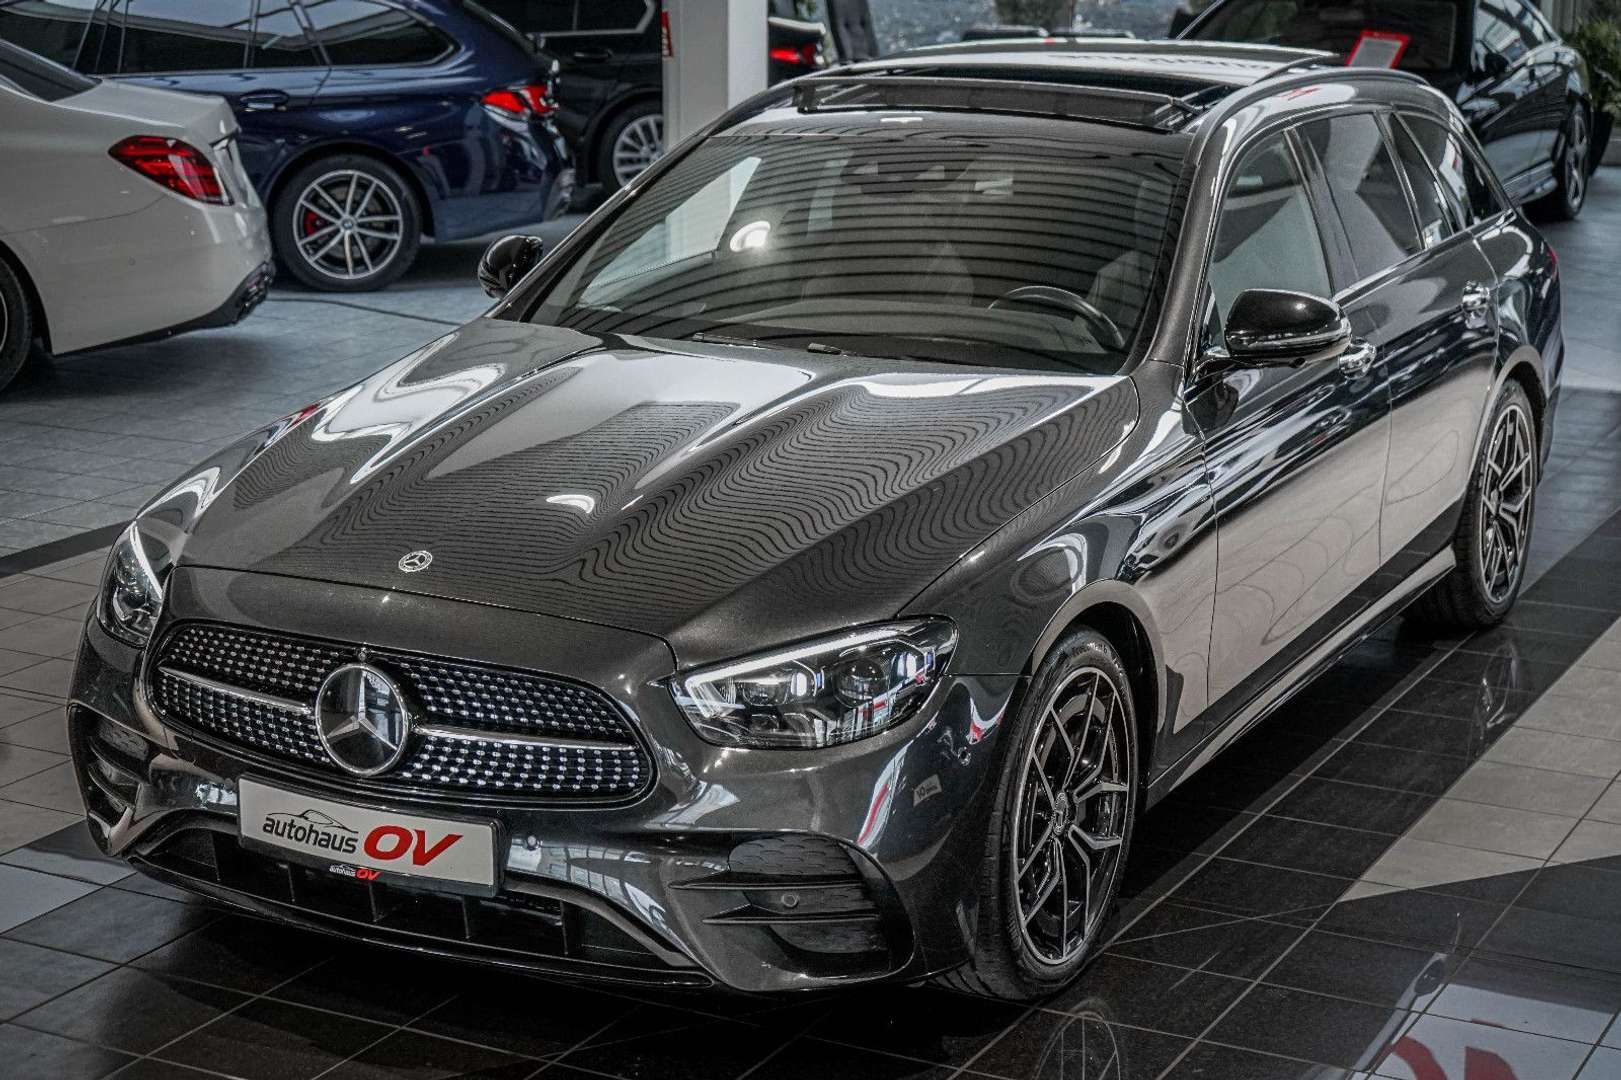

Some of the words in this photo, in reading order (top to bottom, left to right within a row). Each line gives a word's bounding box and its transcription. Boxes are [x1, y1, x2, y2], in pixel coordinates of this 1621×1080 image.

[262, 816, 358, 854] autohaus
[363, 824, 464, 867] OV
[329, 865, 356, 878] autohaus
[356, 867, 382, 881] OV
